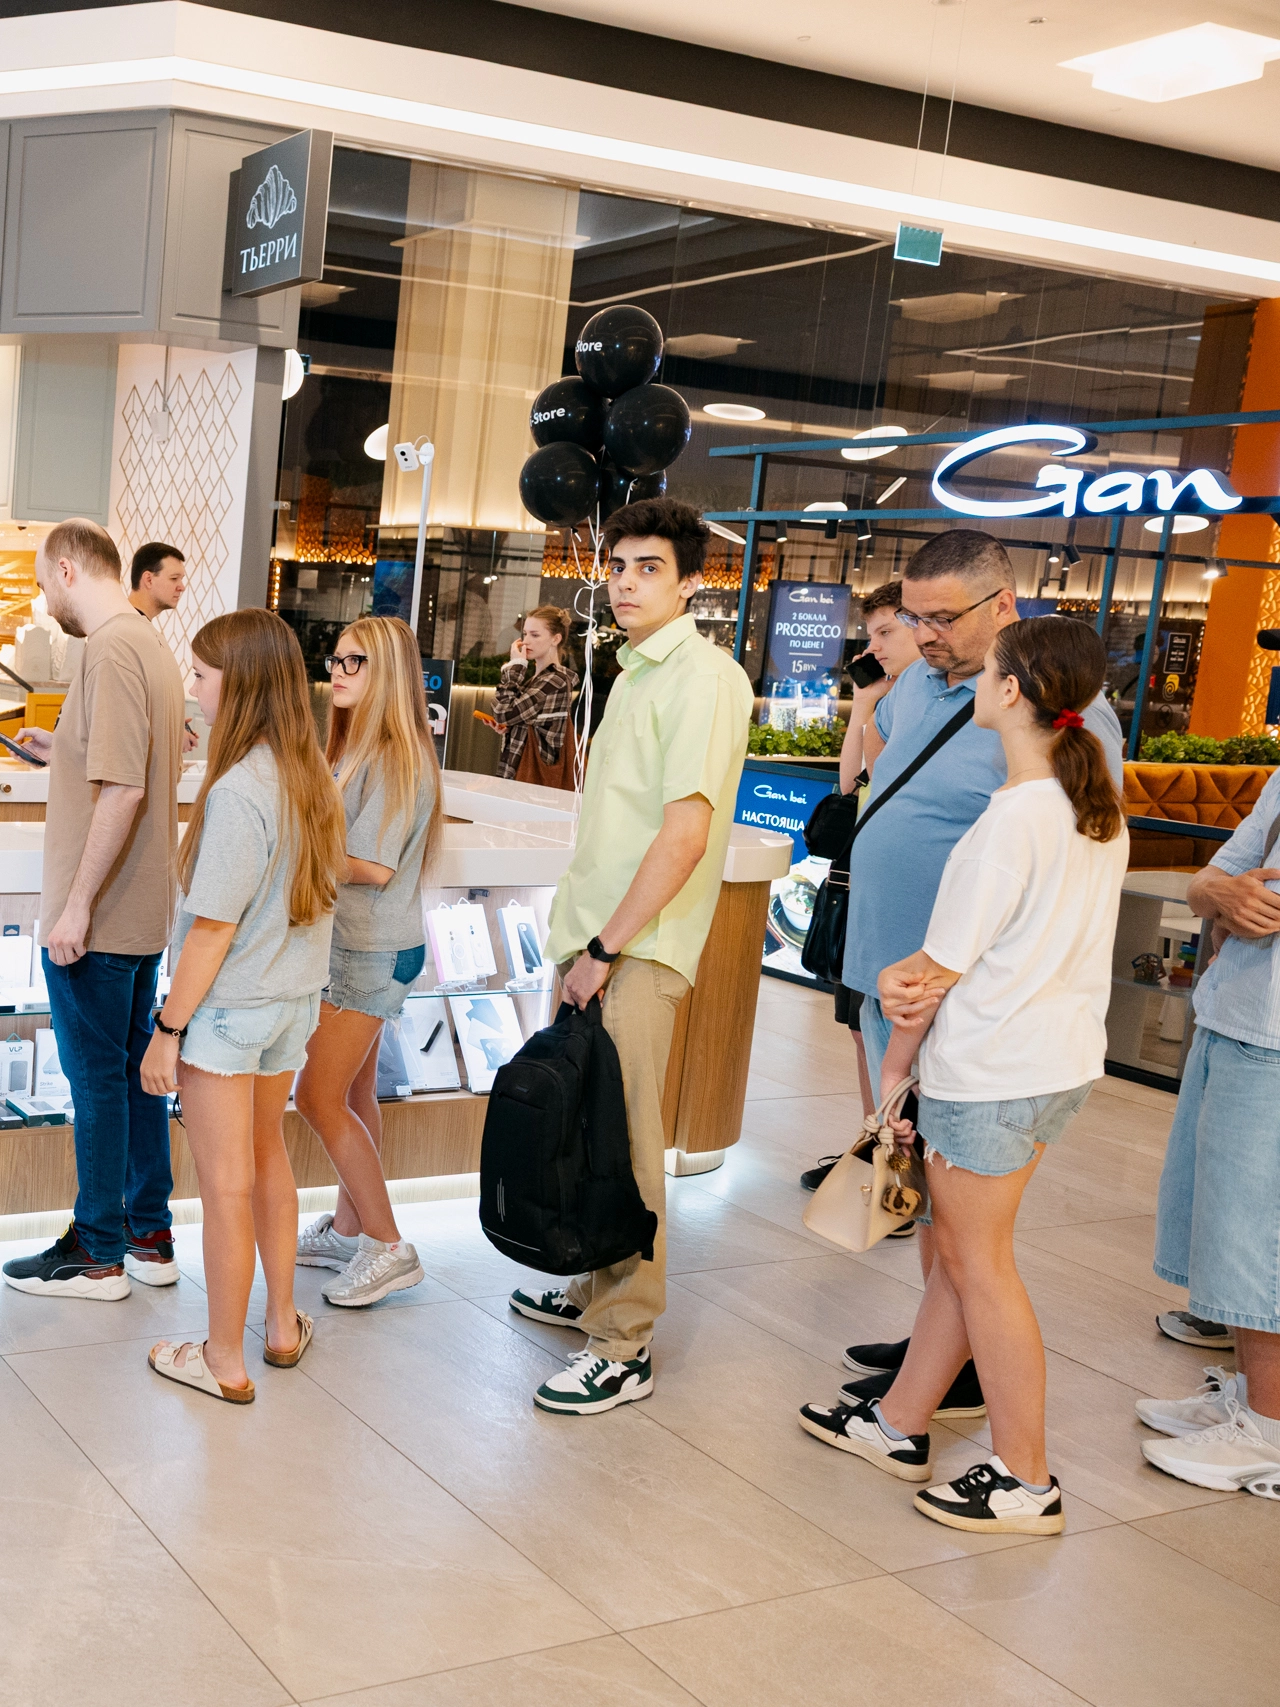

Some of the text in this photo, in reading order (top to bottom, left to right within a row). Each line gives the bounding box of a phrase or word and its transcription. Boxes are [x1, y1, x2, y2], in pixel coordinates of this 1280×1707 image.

[239, 232, 298, 274] ТЬЕРРИ
[575, 340, 603, 352] Store
[931, 423, 1243, 518] Gan
[792, 612, 827, 622] 2 БОКАЛА
[775, 622, 841, 639] PROSECCO
[789, 640, 801, 648] ПО
[802, 640, 820, 650] ЦЕНЕ
[790, 790, 807, 804] bei
[742, 810, 805, 832] НАСТОЯЩА
